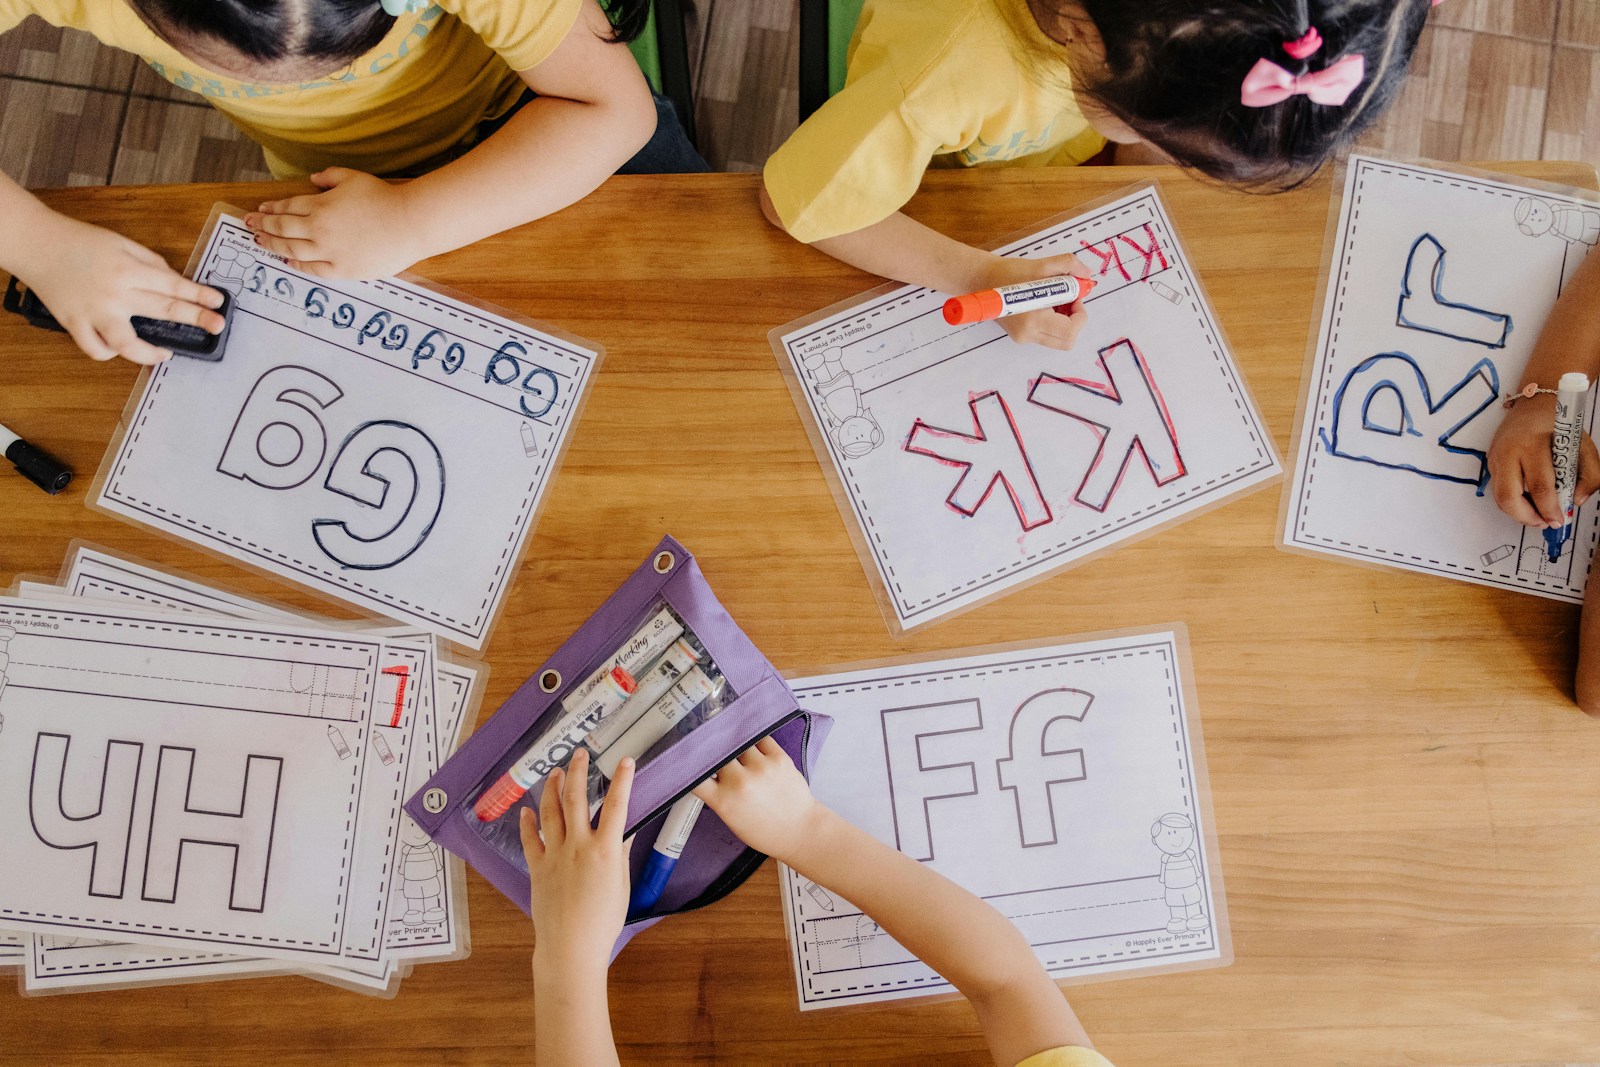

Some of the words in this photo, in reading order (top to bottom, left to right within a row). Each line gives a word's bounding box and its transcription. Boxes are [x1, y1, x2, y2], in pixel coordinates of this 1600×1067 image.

[226, 237, 250, 251] Primary
[252, 247, 266, 256] Ever
[829, 335, 844, 343] Ever
[844, 325, 866, 338] Happily
[803, 341, 829, 354] Primary
[1324, 232, 1512, 492] Rr
[902, 337, 1189, 533] Kk
[216, 364, 446, 570] Gg
[13, 619, 28, 627] Ever
[30, 619, 52, 629] Happily
[614, 634, 649, 666] Marking
[560, 720, 578, 736] Para
[575, 700, 600, 721] Pizarra
[528, 704, 604, 777] BOLIK
[880, 687, 1095, 862] Ff
[28, 732, 285, 913] Hh
[388, 929, 403, 937] ver
[404, 926, 437, 935] Primary
[1132, 938, 1156, 947] Happily
[1174, 932, 1201, 940] Primary
